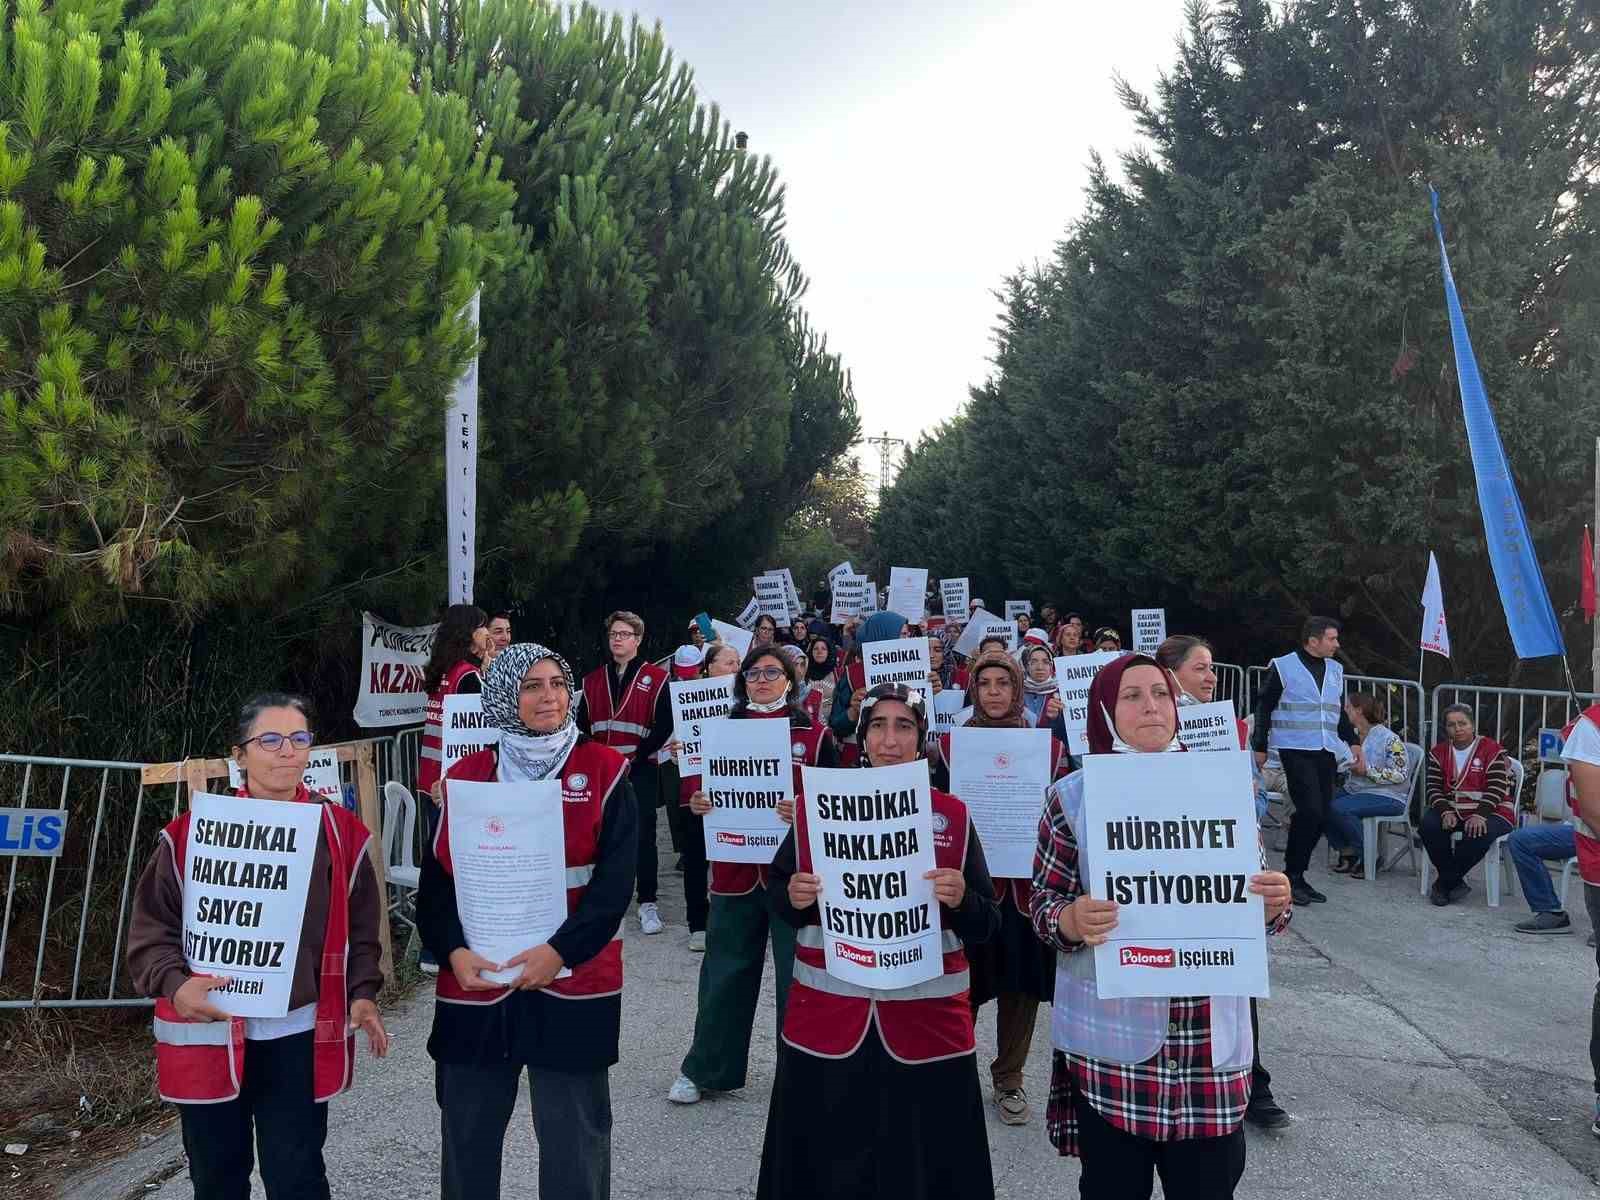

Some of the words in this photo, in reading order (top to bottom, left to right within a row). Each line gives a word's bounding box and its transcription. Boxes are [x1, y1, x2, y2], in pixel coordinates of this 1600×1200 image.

[871, 648, 920, 666] SENDİKAL
[369, 662, 427, 694] KAZAN
[870, 670, 925, 686] HAKLARIMIZI
[678, 687, 729, 705] SENDİKAL
[682, 703, 729, 721] HAKLARA
[1184, 717, 1214, 730] MADDE
[709, 756, 780, 777] HÜRRİYET
[709, 787, 785, 809] İSTİYORUZ
[817, 788, 919, 822] SENDİKAL
[195, 817, 297, 853] SENDİKAL
[747, 834, 779, 848] İŞÇİLERİ
[823, 828, 919, 861] HAKLARA
[1106, 814, 1237, 851] HÜRRİYET
[192, 855, 288, 891] HAKLARA
[842, 870, 907, 901] SAYGI
[1105, 871, 1248, 905] İSTİYORUZ
[196, 895, 263, 928] SAYGI
[825, 902, 931, 940] İSTİYORUZ
[184, 928, 285, 968] İSTİYORUZ
[836, 944, 875, 965] Polonez
[879, 944, 923, 970] İŞÇİLERİ
[1121, 949, 1173, 965] Polonez
[1179, 948, 1235, 969] İŞÇİLERİ
[217, 976, 264, 996] ÇİLERİ
